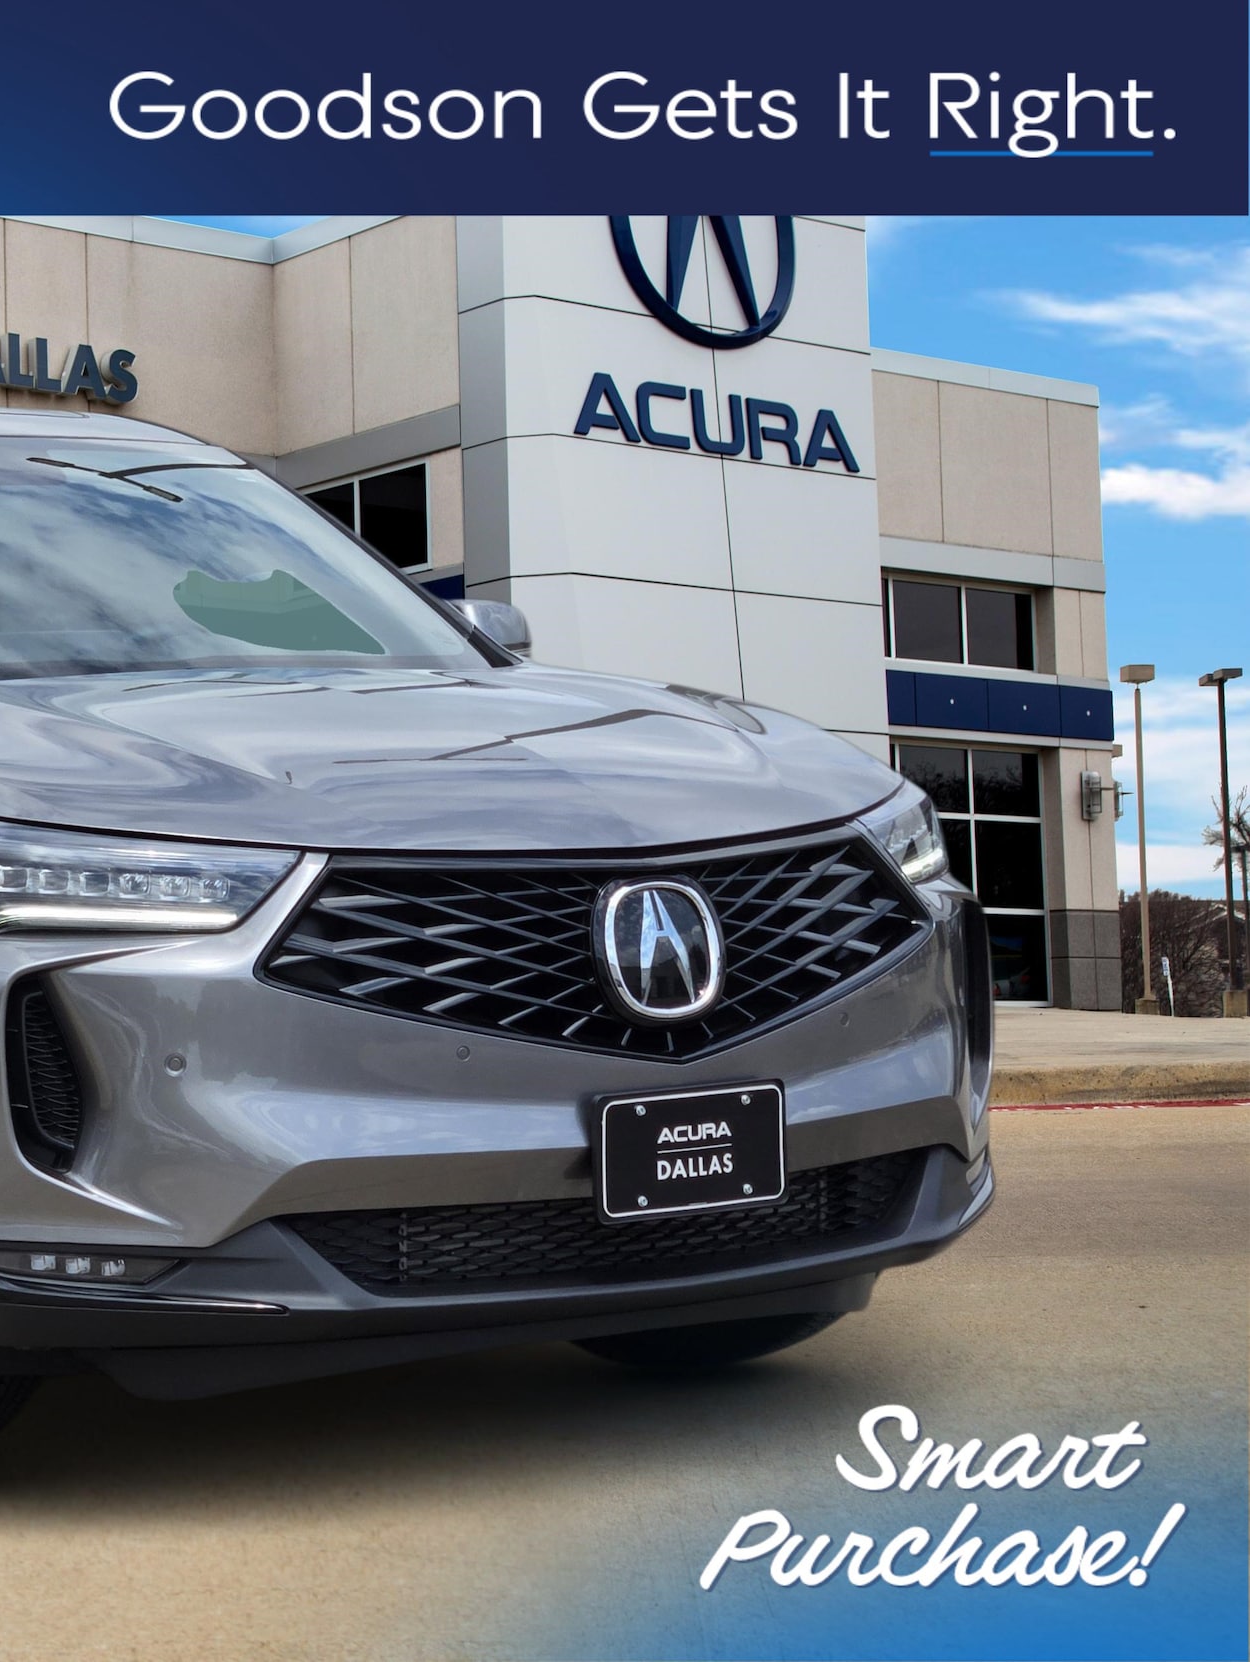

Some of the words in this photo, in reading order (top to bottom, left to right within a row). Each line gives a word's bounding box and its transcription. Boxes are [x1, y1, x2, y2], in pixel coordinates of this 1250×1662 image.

[573, 372, 860, 473] ACURA
[657, 1121, 732, 1144] ACURA
[657, 1153, 733, 1180] DALLAS
